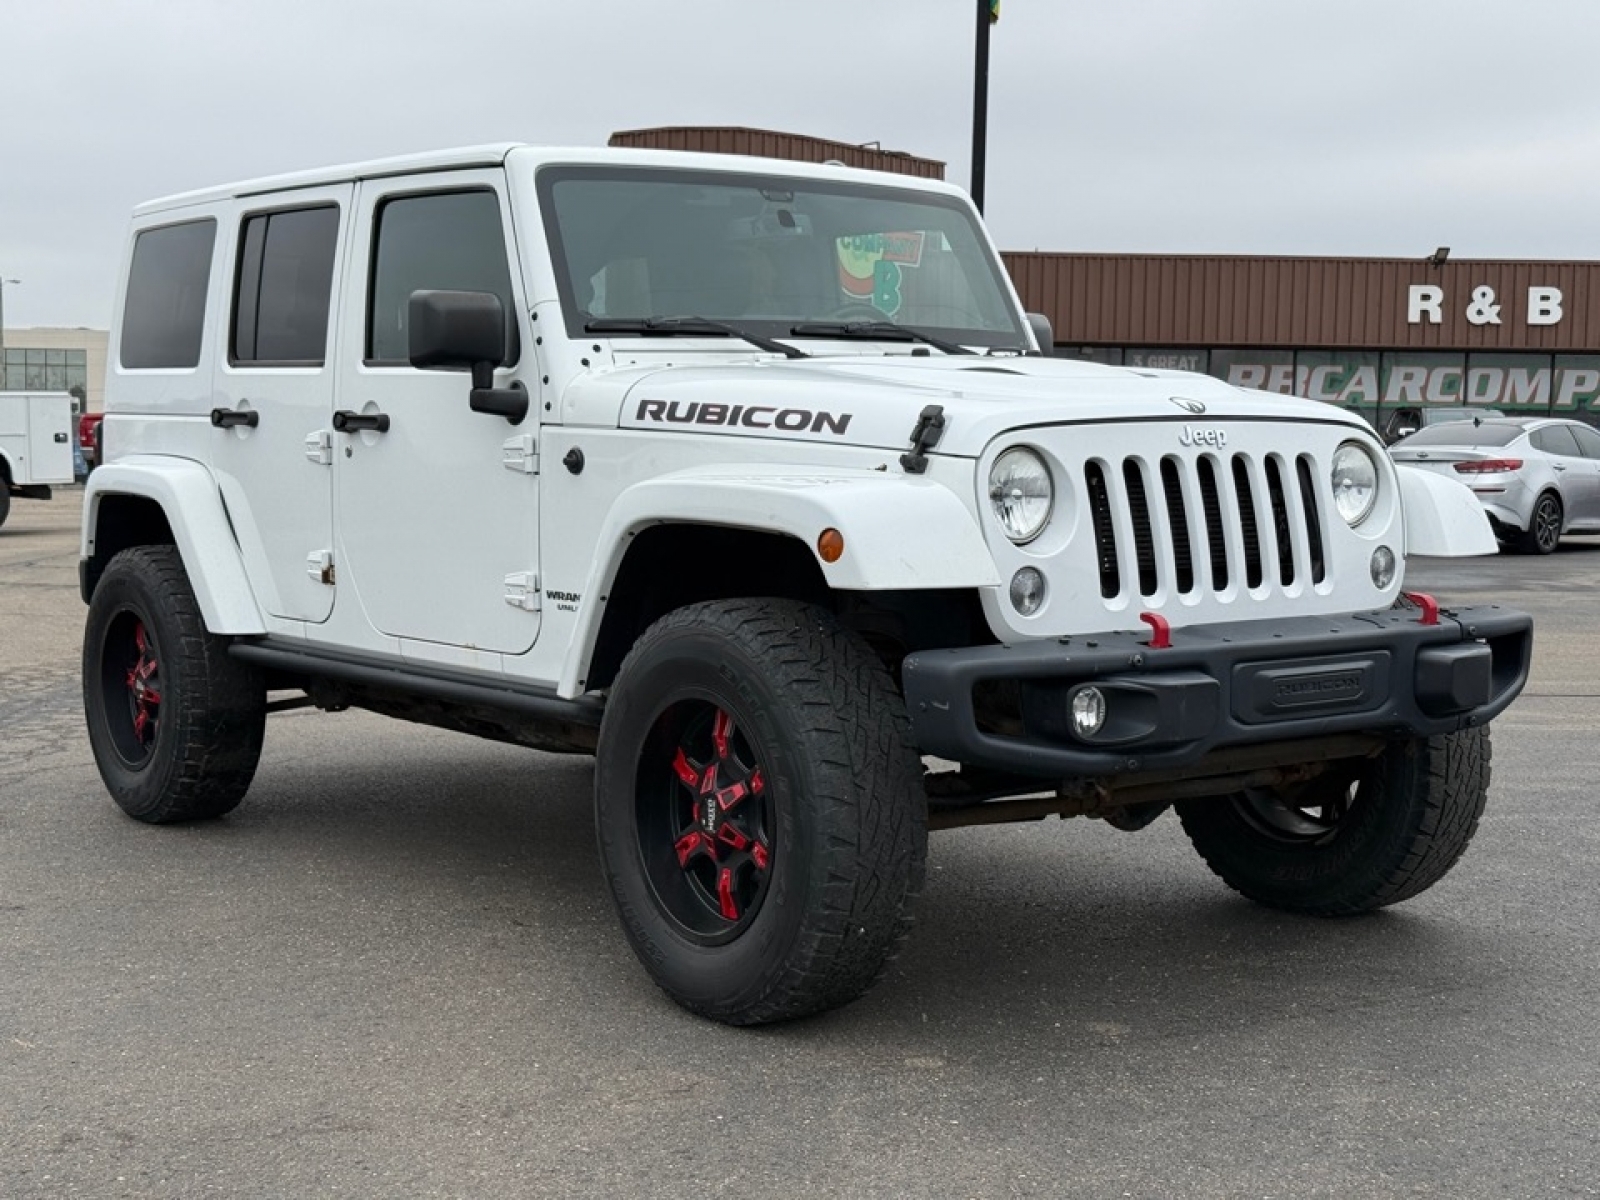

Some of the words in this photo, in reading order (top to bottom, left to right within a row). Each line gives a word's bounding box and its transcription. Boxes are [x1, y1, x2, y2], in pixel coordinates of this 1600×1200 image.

[1408, 285, 1444, 323] R
[1466, 285, 1502, 325] &
[1527, 286, 1563, 325] B
[1148, 354, 1198, 371] GREAT
[1228, 364, 1600, 405] RBCARCOMP
[635, 399, 853, 435] RUBICON
[1178, 424, 1227, 450] Jeep
[546, 590, 581, 602] WRAN
